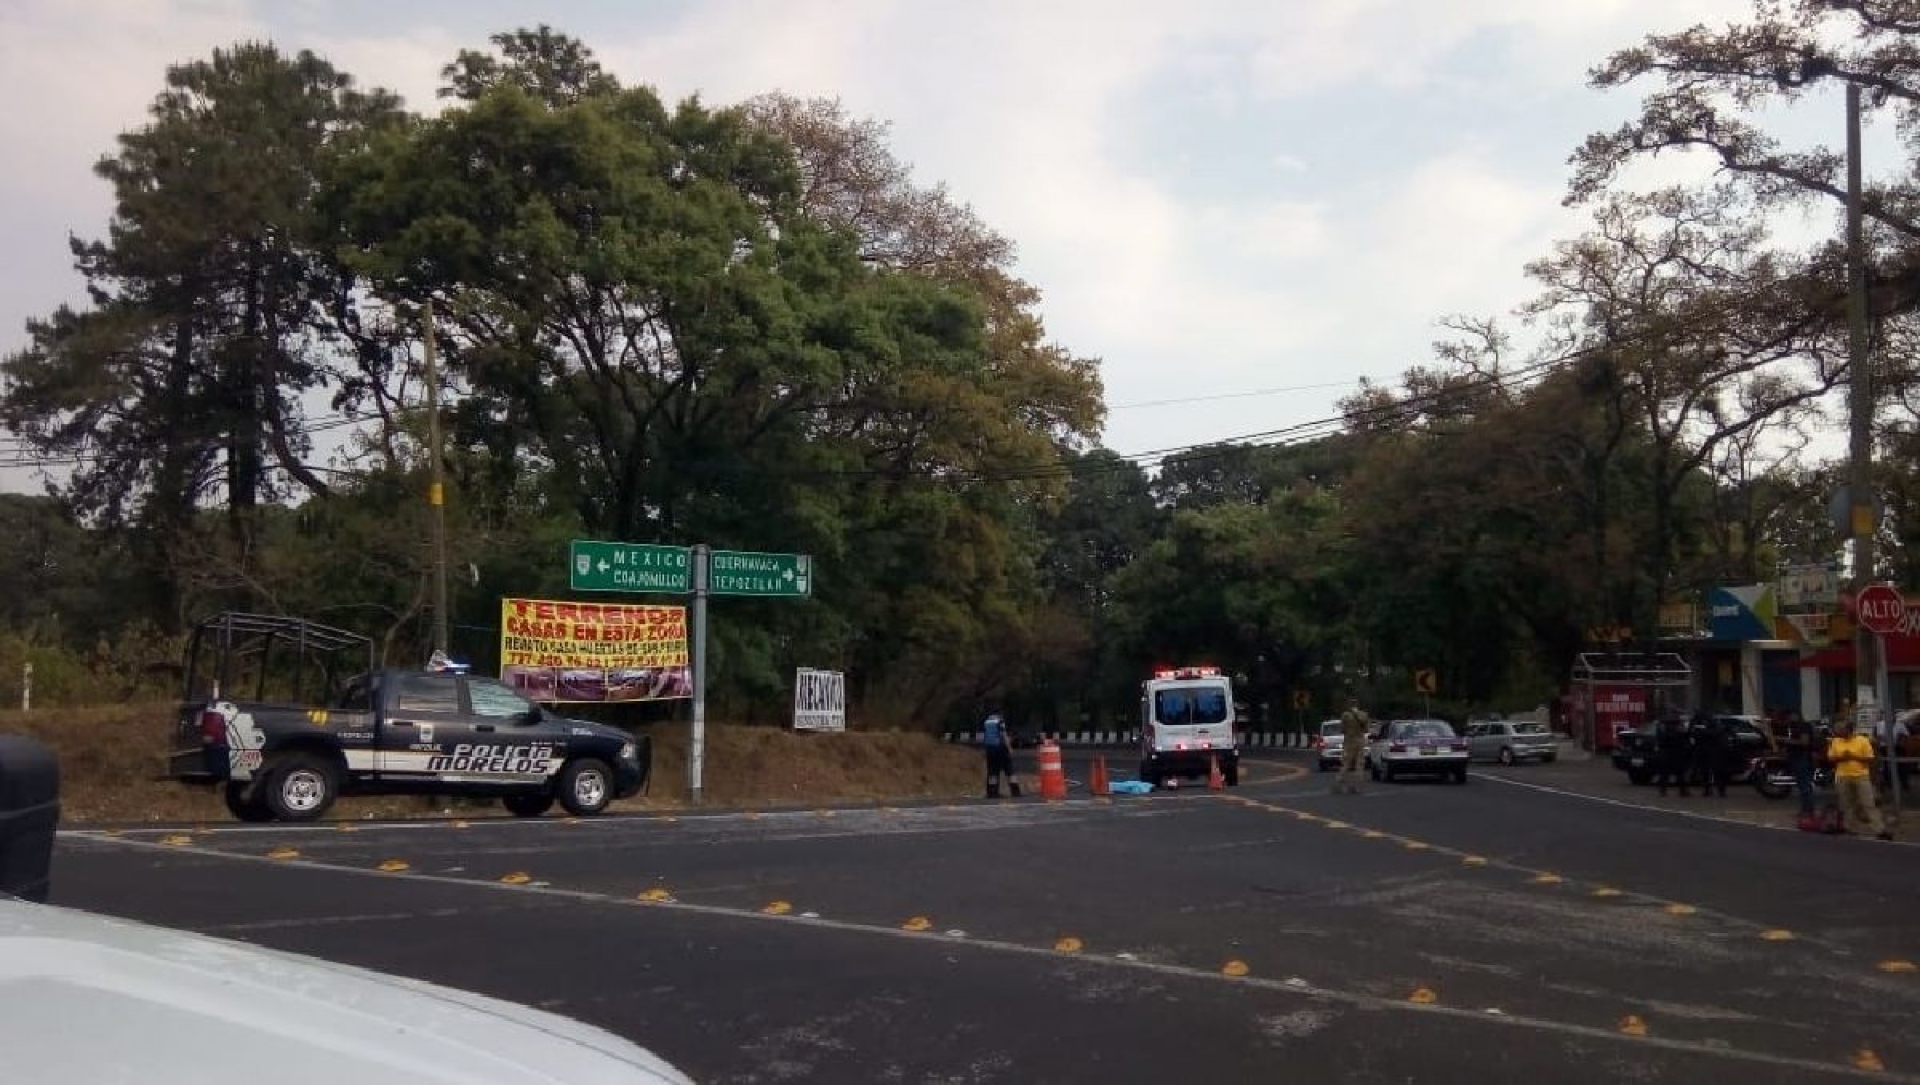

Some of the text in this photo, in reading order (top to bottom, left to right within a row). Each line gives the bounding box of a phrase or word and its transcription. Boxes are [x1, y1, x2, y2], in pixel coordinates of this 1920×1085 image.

[614, 550, 686, 568] MEXICO
[715, 554, 780, 572] CUERNAVACA
[509, 601, 685, 624] TERRENOS
[1862, 599, 1900, 619] ALTO
[507, 616, 566, 640] CASAS
[573, 624, 598, 641] EN
[602, 625, 642, 641] ESTA
[426, 757, 549, 773] MORELOS
